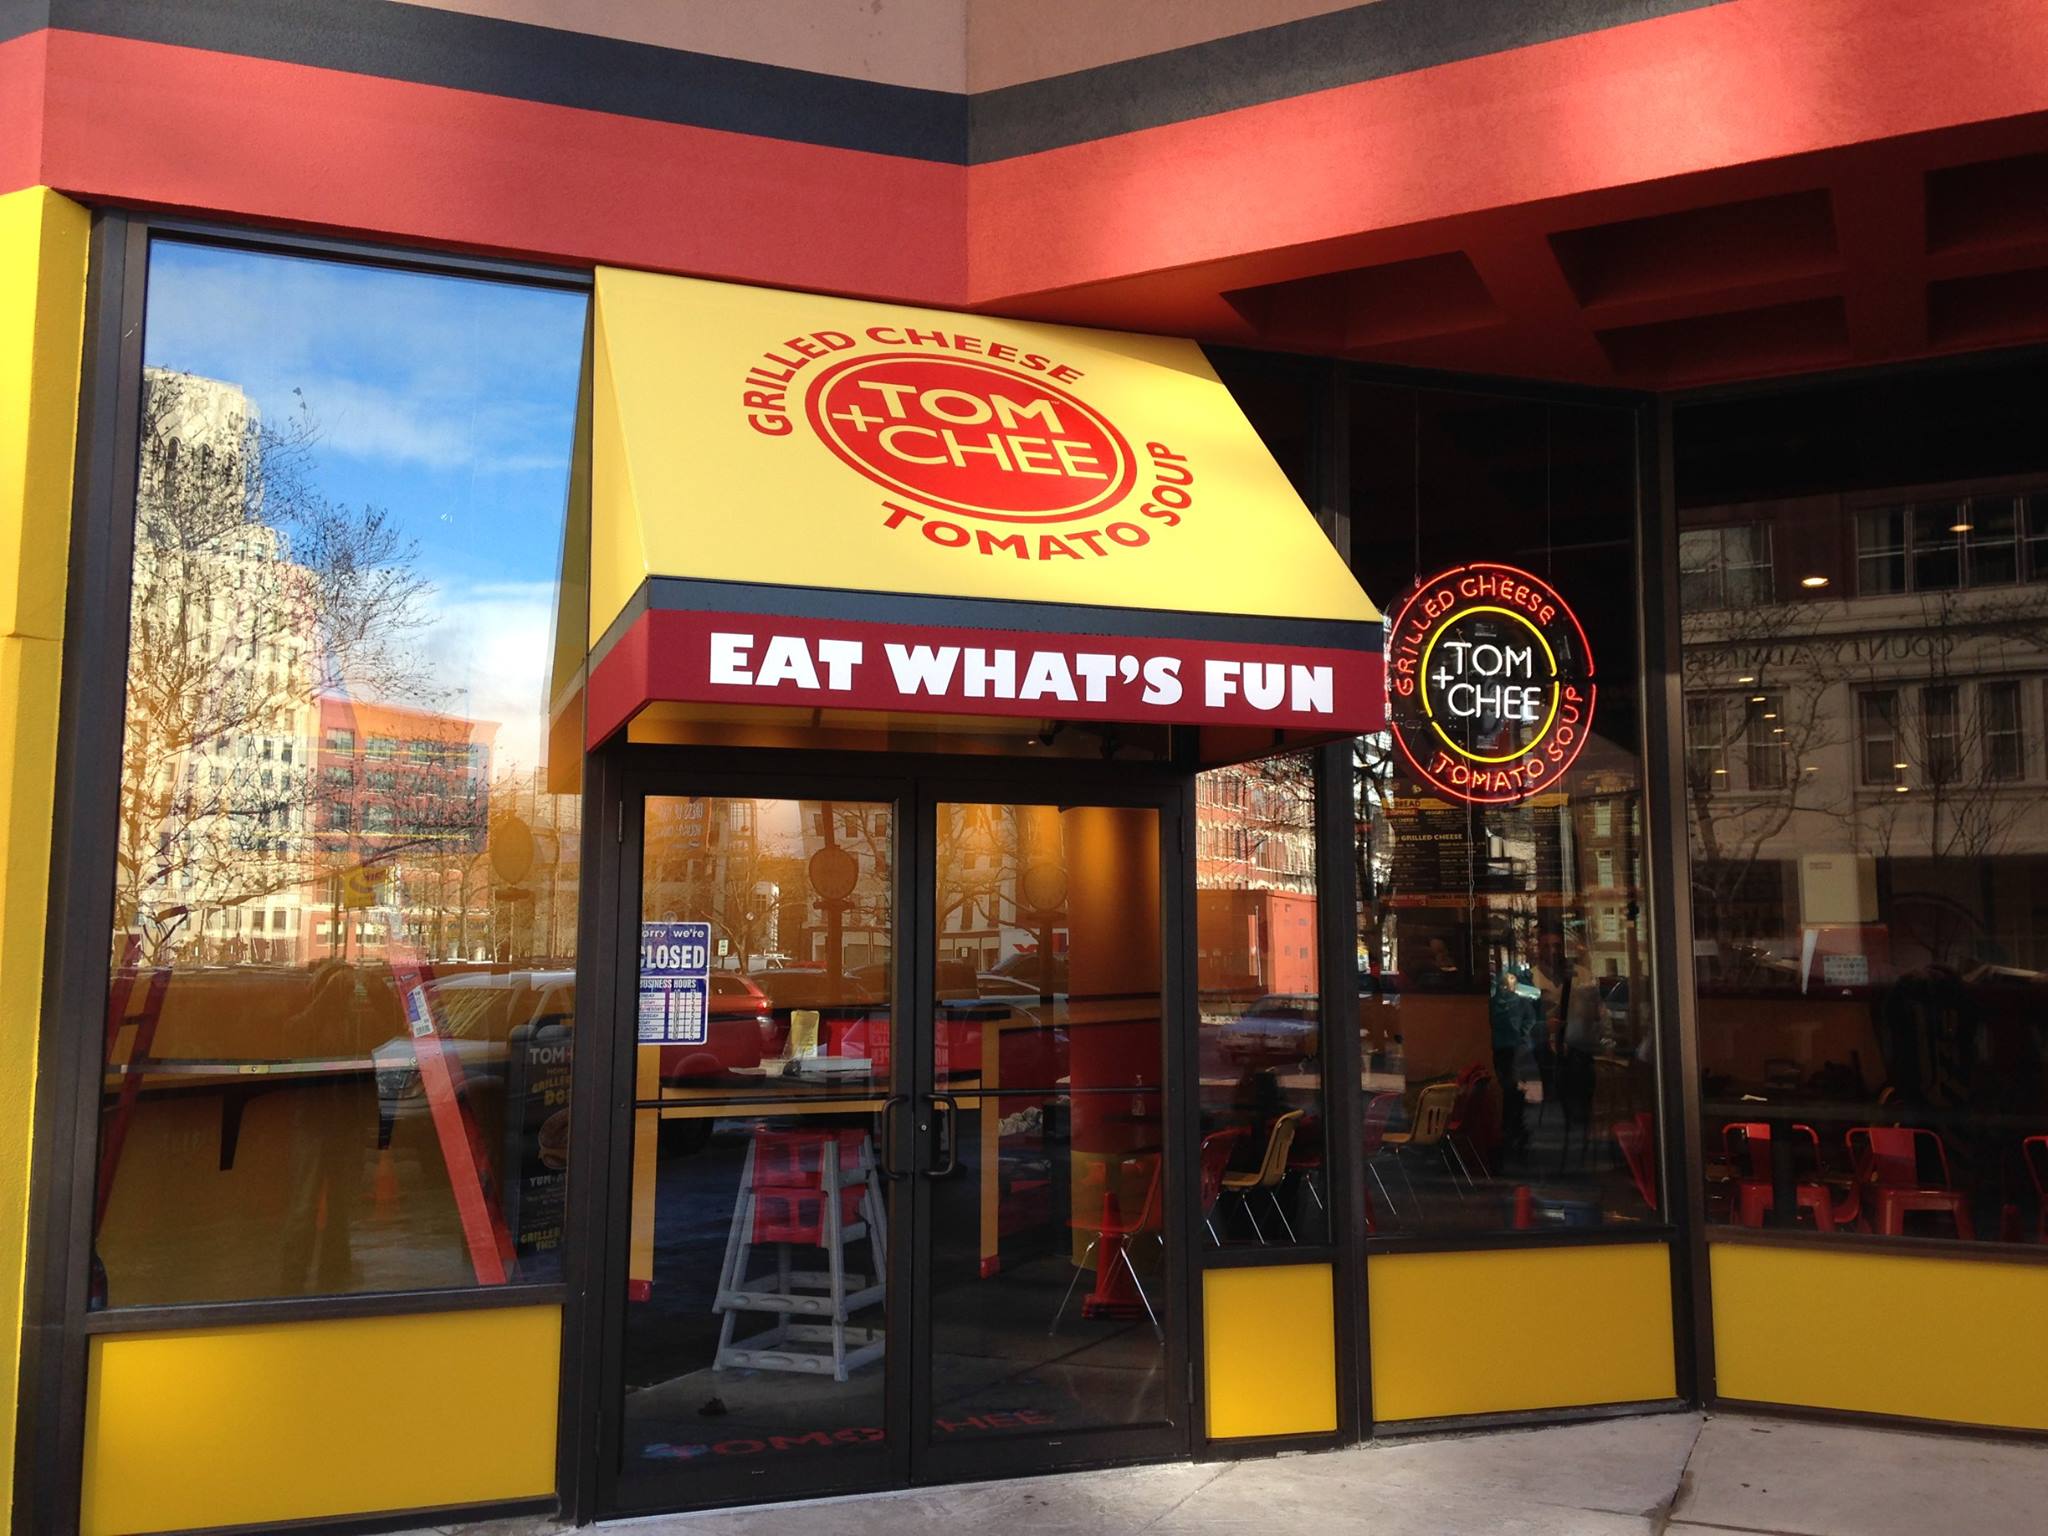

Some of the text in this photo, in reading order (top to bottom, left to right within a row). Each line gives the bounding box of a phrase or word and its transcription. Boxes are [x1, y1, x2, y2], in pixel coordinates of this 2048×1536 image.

[743, 327, 1085, 436] GRILLED CHEESE
[858, 380, 1067, 434] TOM
[881, 441, 1194, 561] TOMATO SOUP
[710, 632, 1334, 713] EAT WHAT'S FUN
[1395, 575, 1556, 697] GRILLED CHEESE
[1443, 642, 1532, 679] TOM
[1434, 686, 1583, 792] TOMATO SOUP
[642, 929, 666, 938] orry
